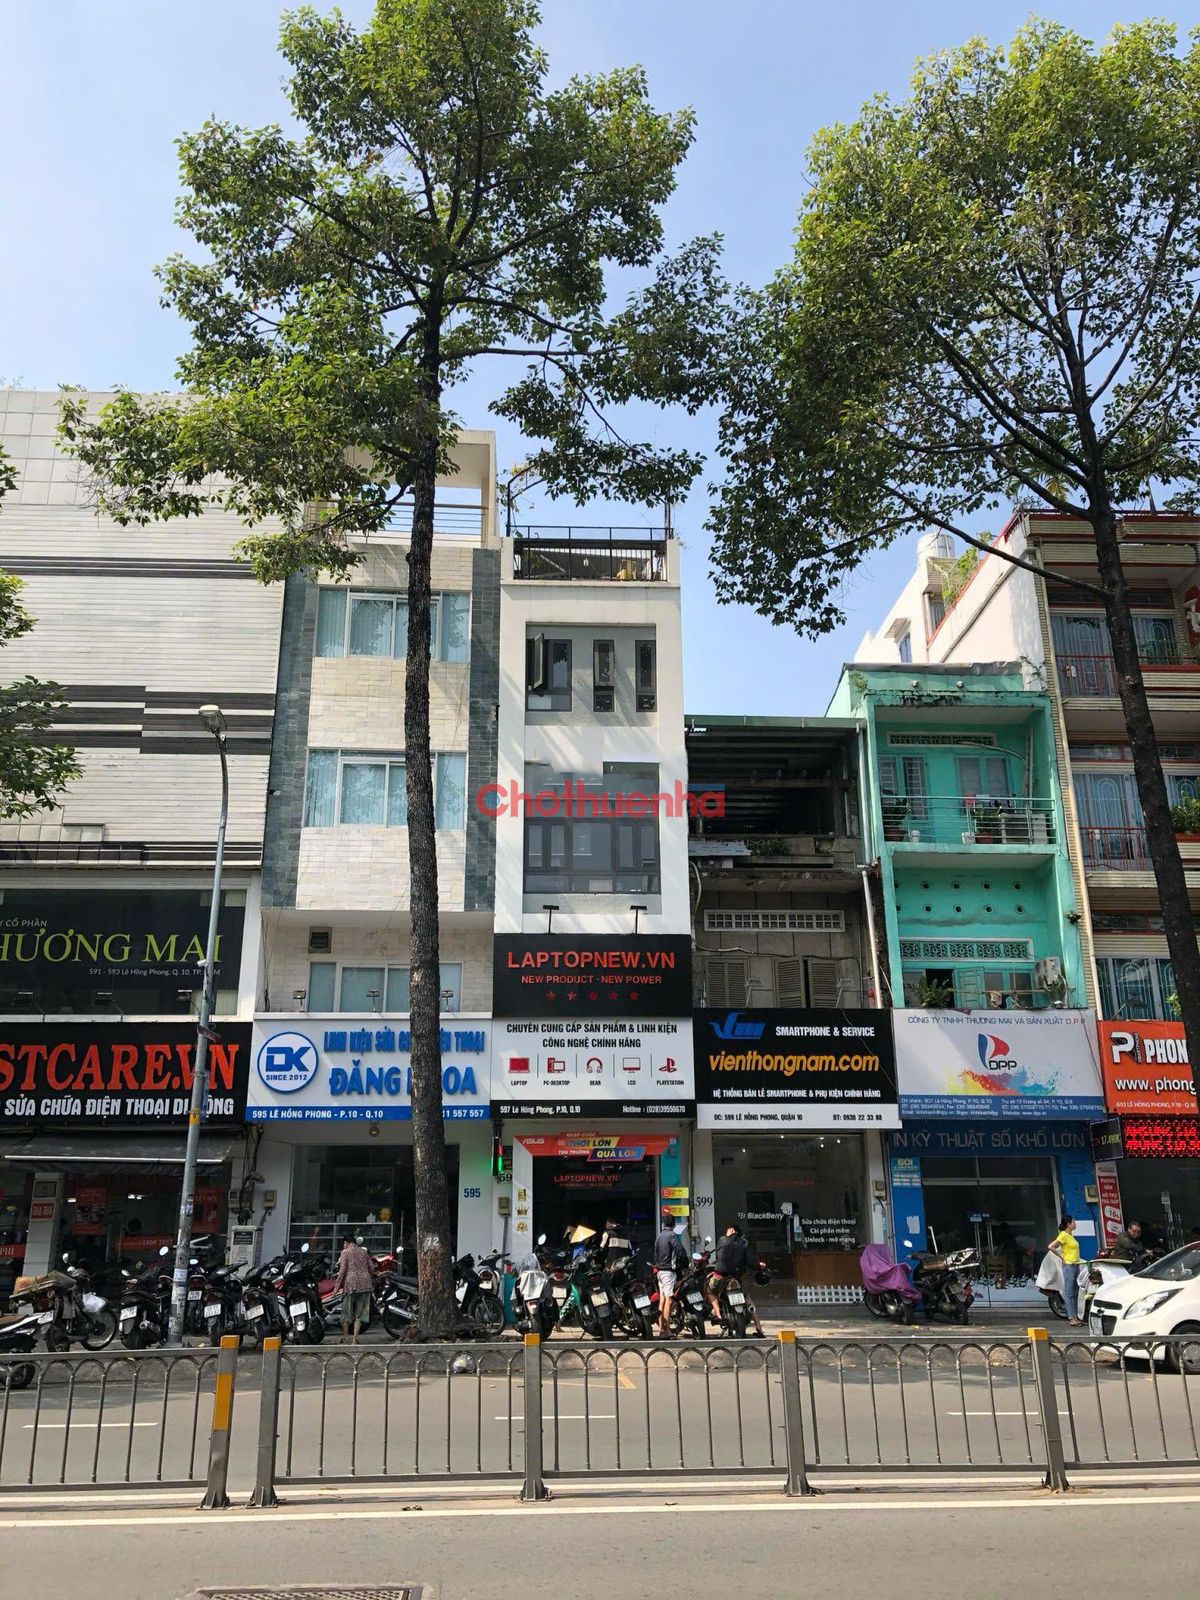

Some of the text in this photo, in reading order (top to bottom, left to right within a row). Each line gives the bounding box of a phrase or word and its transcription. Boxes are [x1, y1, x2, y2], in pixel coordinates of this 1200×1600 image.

[142, 934, 223, 963] MAI
[507, 951, 675, 969] LAPTOPNEW.VN
[521, 975, 544, 984] NEW
[546, 975, 593, 984] PRODUCT
[601, 975, 623, 984] NEW
[626, 975, 662, 984] POWER
[907, 1016, 929, 1024] CÔNG
[943, 1017, 964, 1025] TNHH
[507, 1022, 539, 1033] CHUYÊN
[541, 1023, 564, 1033] CUNG
[566, 1020, 582, 1033] CẤP
[629, 1024, 635, 1033] &
[637, 1024, 656, 1034] LINH
[658, 1021, 677, 1035] KIỆN
[776, 1026, 875, 1037] SMARTPHONE & SERVICE
[324, 1032, 347, 1052] LINH
[350, 1027, 372, 1055] KIỆN
[375, 1025, 395, 1052] SỬA
[454, 1032, 485, 1055] THOẠI
[542, 1036, 565, 1048] CÔNG
[567, 1036, 589, 1050] NGHỆ
[592, 1036, 617, 1048] CHÍNH
[265, 1047, 311, 1072] DK
[708, 1051, 879, 1077] vienthongnam.com
[988, 1060, 1017, 1071] DPP
[329, 1059, 400, 1096] ĐĂNG
[766, 1090, 807, 1098] SMARTPHONE
[828, 1088, 843, 1098] KIỆN
[5, 1093, 35, 1116] SỬA
[41, 1094, 81, 1116] CHỮA
[85, 1095, 120, 1119] ĐIỆN
[126, 1098, 169, 1119] THOẠI
[204, 1094, 234, 1119] ỘNG
[500, 1106, 511, 1114] 597
[512, 1105, 519, 1114] Lê
[622, 1105, 641, 1113] Hotline
[252, 1110, 267, 1118] 595
[269, 1109, 279, 1118] LÊ
[281, 1107, 303, 1118] HỒNG
[305, 1110, 332, 1119] PHONG
[340, 1110, 357, 1119] P.10
[366, 1110, 384, 1119] Q.10
[452, 1110, 484, 1118] 557 557
[937, 1126, 985, 1150] THUẬT
[992, 1127, 1011, 1147] SỐ
[1052, 1126, 1085, 1147] LỚN
[463, 1188, 481, 1198] 595
[695, 1197, 712, 1207] 599
[747, 1213, 784, 1221] BlackBerry
[426, 1237, 439, 1246] 72
